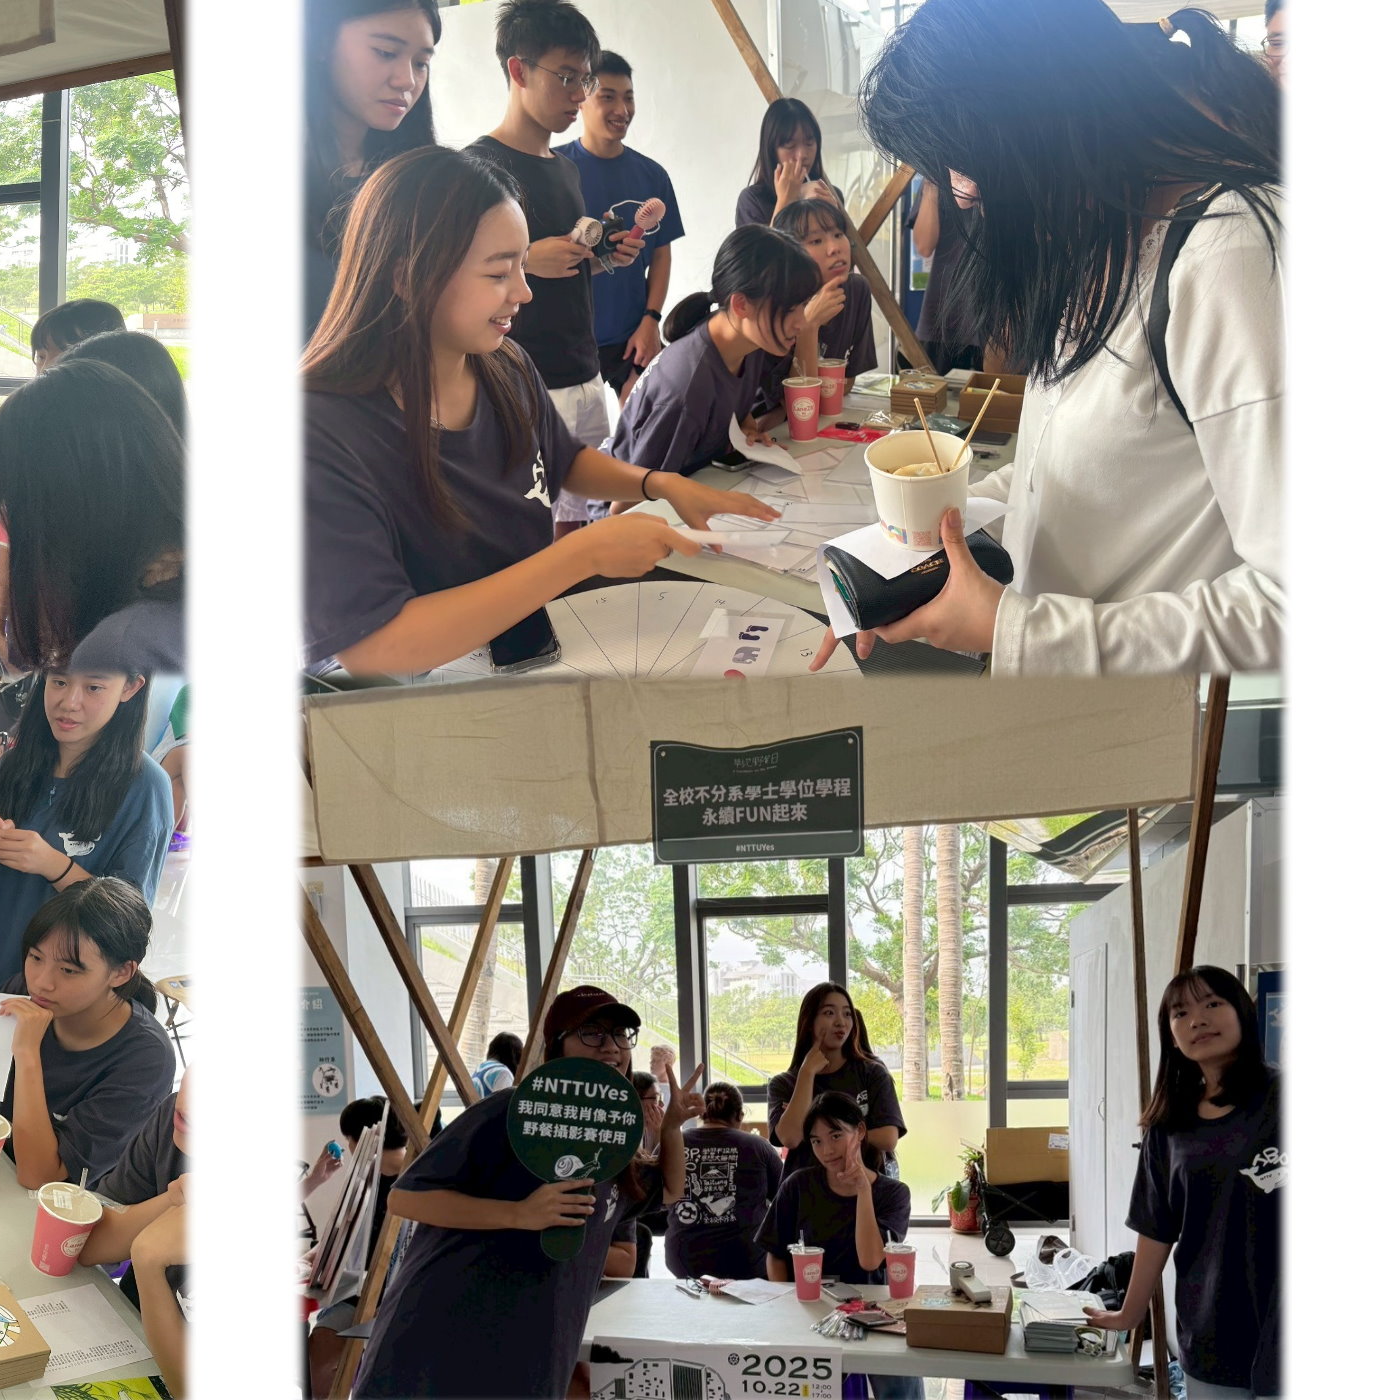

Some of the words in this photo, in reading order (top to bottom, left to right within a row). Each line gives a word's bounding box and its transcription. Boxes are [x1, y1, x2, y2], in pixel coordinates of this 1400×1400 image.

[663, 778, 852, 807] 全校不分系學士學位學程
[702, 803, 808, 827] 永續FUN起來
[735, 844, 775, 853] #NTTUYes
[531, 1076, 629, 1102] #NTTUYes
[518, 1100, 636, 1126] 我同意我肖像予你
[522, 1120, 627, 1145] 野餐攝影賽使用
[741, 1354, 833, 1380] 2025
[742, 1380, 801, 1396] 10.22
